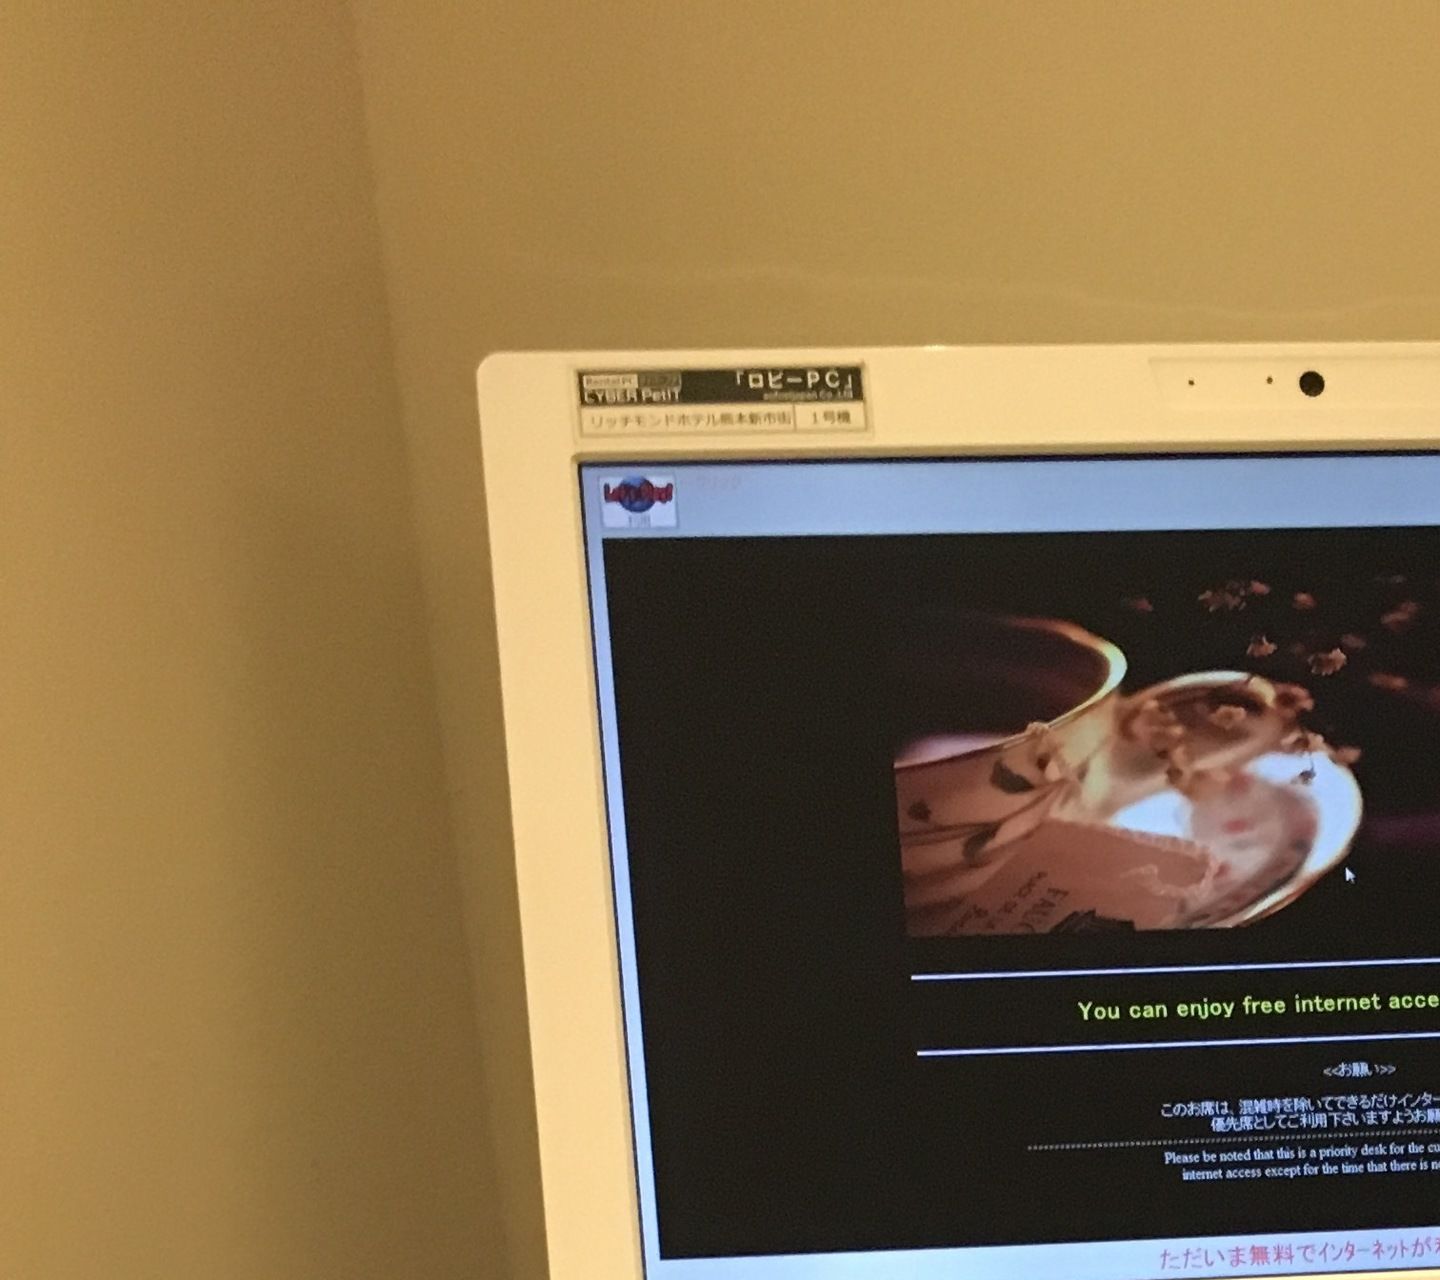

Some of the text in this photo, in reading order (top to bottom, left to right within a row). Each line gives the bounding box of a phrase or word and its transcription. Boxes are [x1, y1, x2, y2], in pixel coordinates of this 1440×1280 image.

[1078, 1001, 1120, 1020] You
[1129, 1003, 1167, 1018] can
[1176, 998, 1235, 1019] enjoy
[1243, 995, 1286, 1014] free
[1294, 993, 1382, 1013] internet
[1165, 1151, 1200, 1164] Please
[1202, 1150, 1217, 1162] be
[1219, 1149, 1251, 1162] noted
[1253, 1148, 1275, 1160] that
[1277, 1147, 1295, 1159] this
[1298, 1146, 1307, 1158] is
[1309, 1149, 1317, 1158] a
[1319, 1145, 1357, 1162] priority
[1361, 1144, 1388, 1156] desk
[1389, 1143, 1406, 1155] for
[1408, 1142, 1425, 1154] the
[1183, 1168, 1223, 1180] internet
[1226, 1168, 1262, 1179] access
[1264, 1165, 1301, 1178] except
[1303, 1163, 1319, 1175] for
[1322, 1162, 1339, 1174] the
[1342, 1161, 1364, 1173] time
[1367, 1160, 1388, 1172] that
[1390, 1159, 1417, 1171] there
[1420, 1158, 1429, 1170] is
